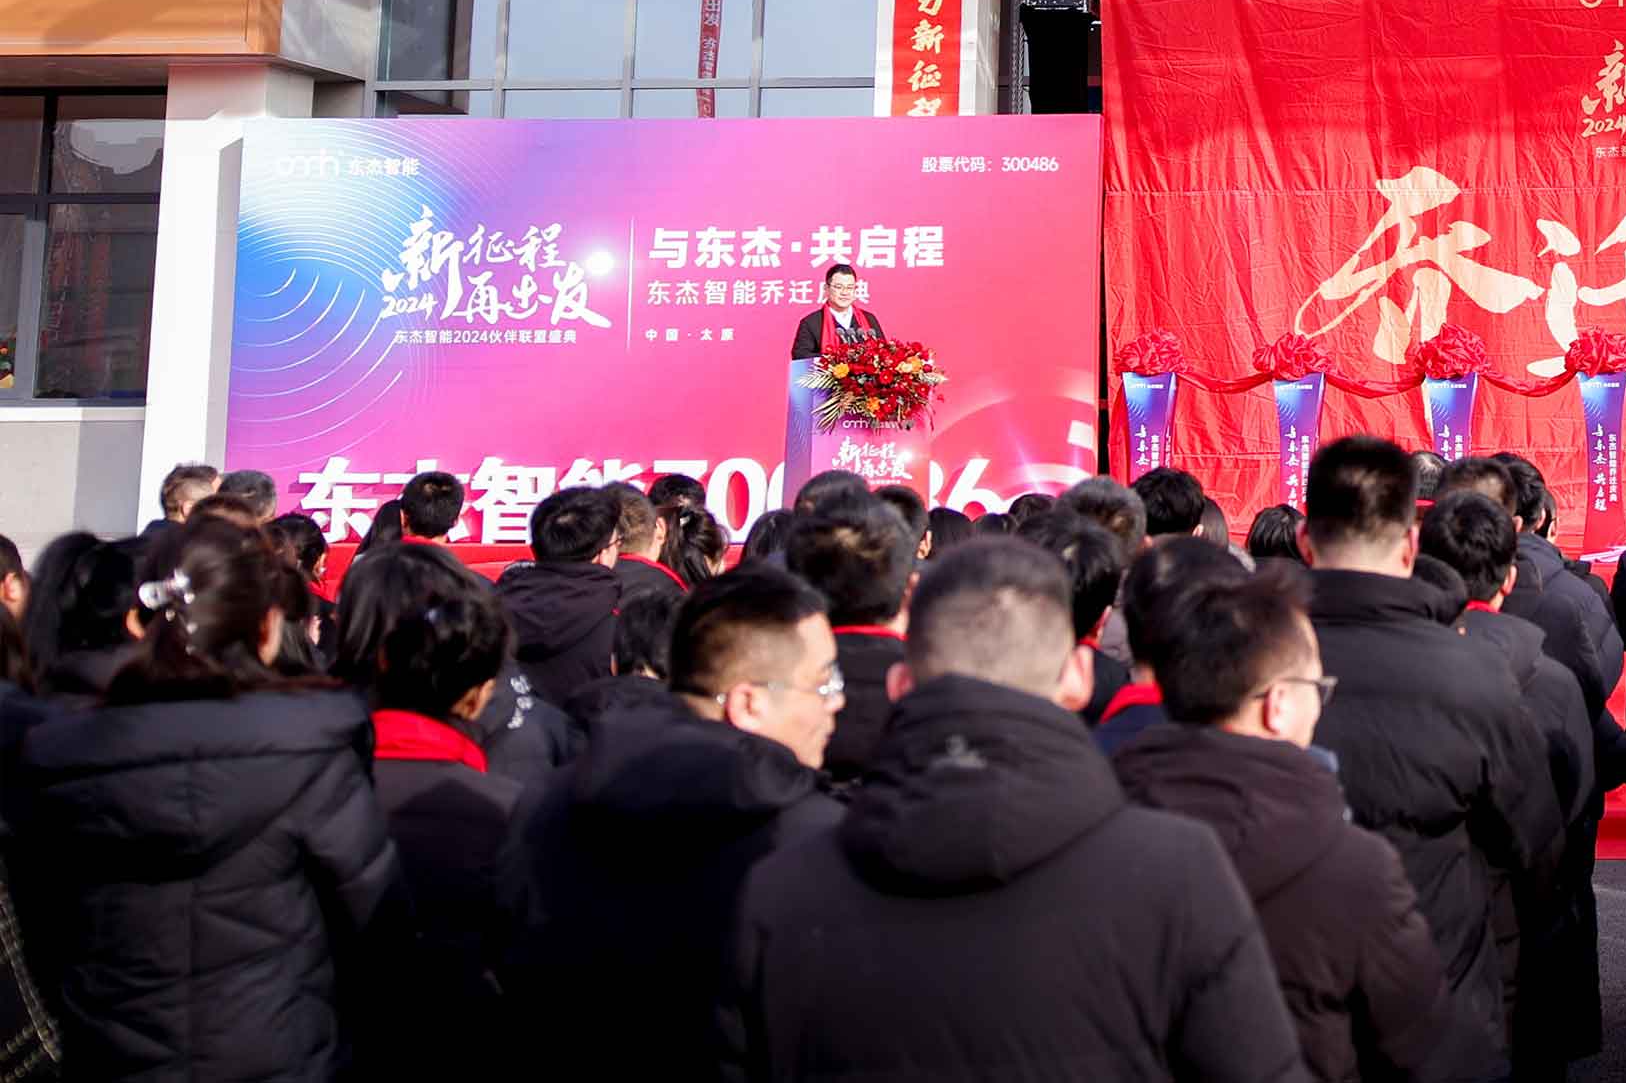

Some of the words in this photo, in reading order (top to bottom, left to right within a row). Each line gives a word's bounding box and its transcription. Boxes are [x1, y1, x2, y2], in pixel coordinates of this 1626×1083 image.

[381, 292, 438, 321] 2024
[394, 328, 577, 345] 东杰智能2024伙伴联盟盛典
